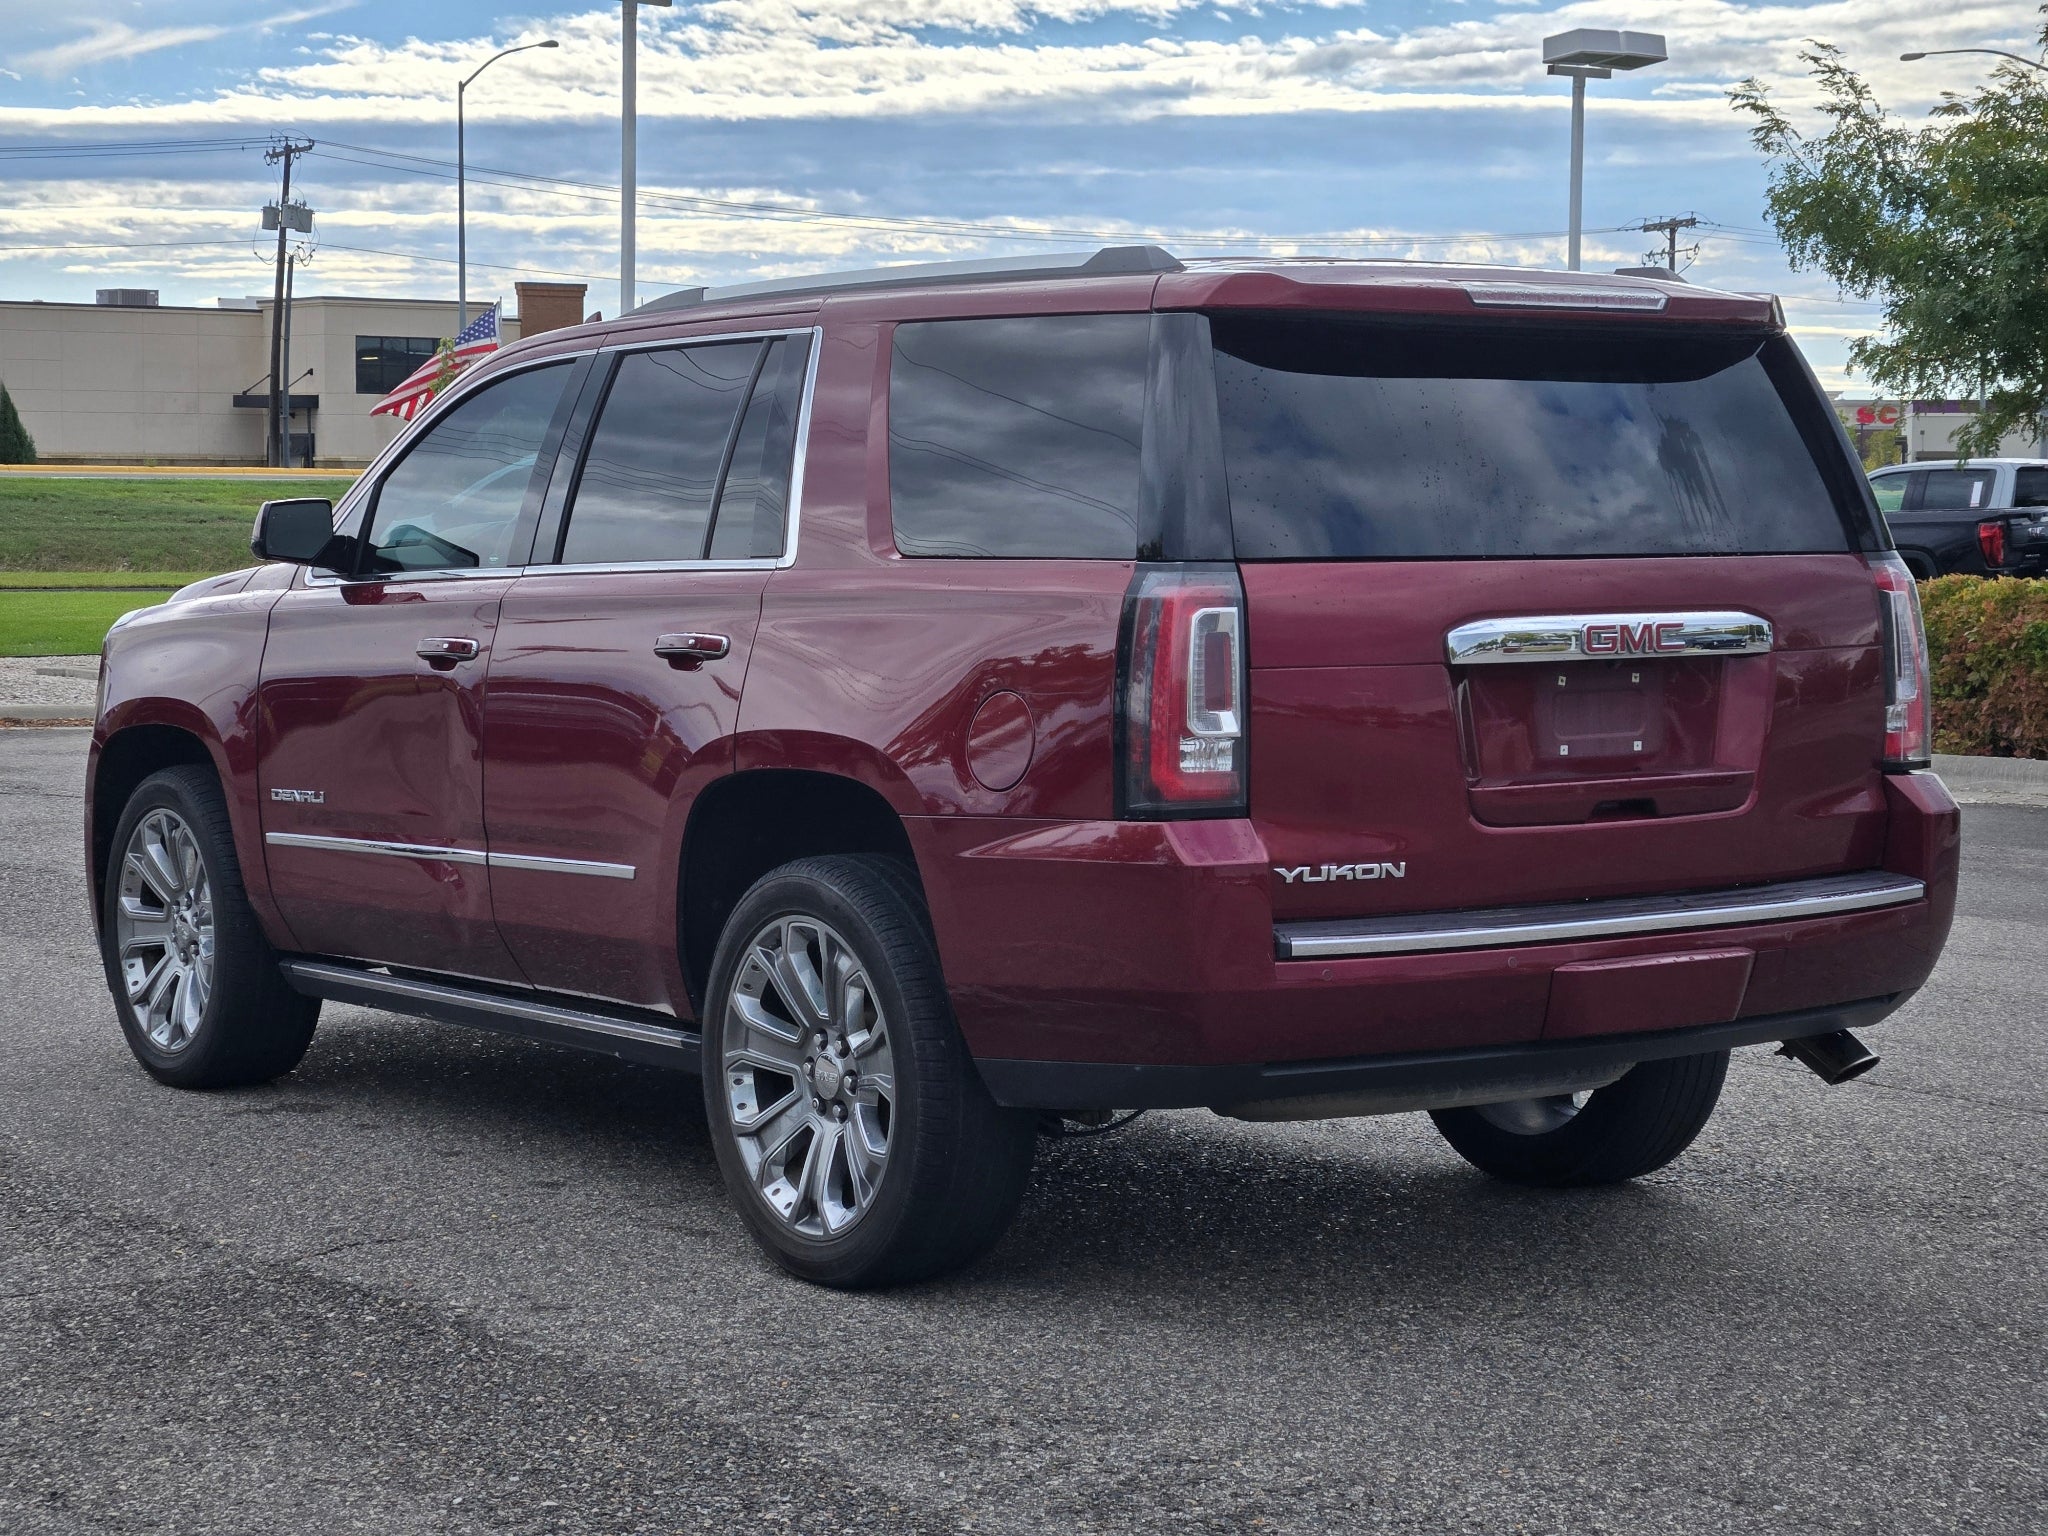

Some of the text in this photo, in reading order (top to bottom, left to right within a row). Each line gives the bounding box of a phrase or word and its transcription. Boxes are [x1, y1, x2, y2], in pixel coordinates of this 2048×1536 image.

[1582, 621, 1686, 655] GMC
[270, 788, 325, 804] DENALI
[1273, 861, 1406, 884] YUKON
